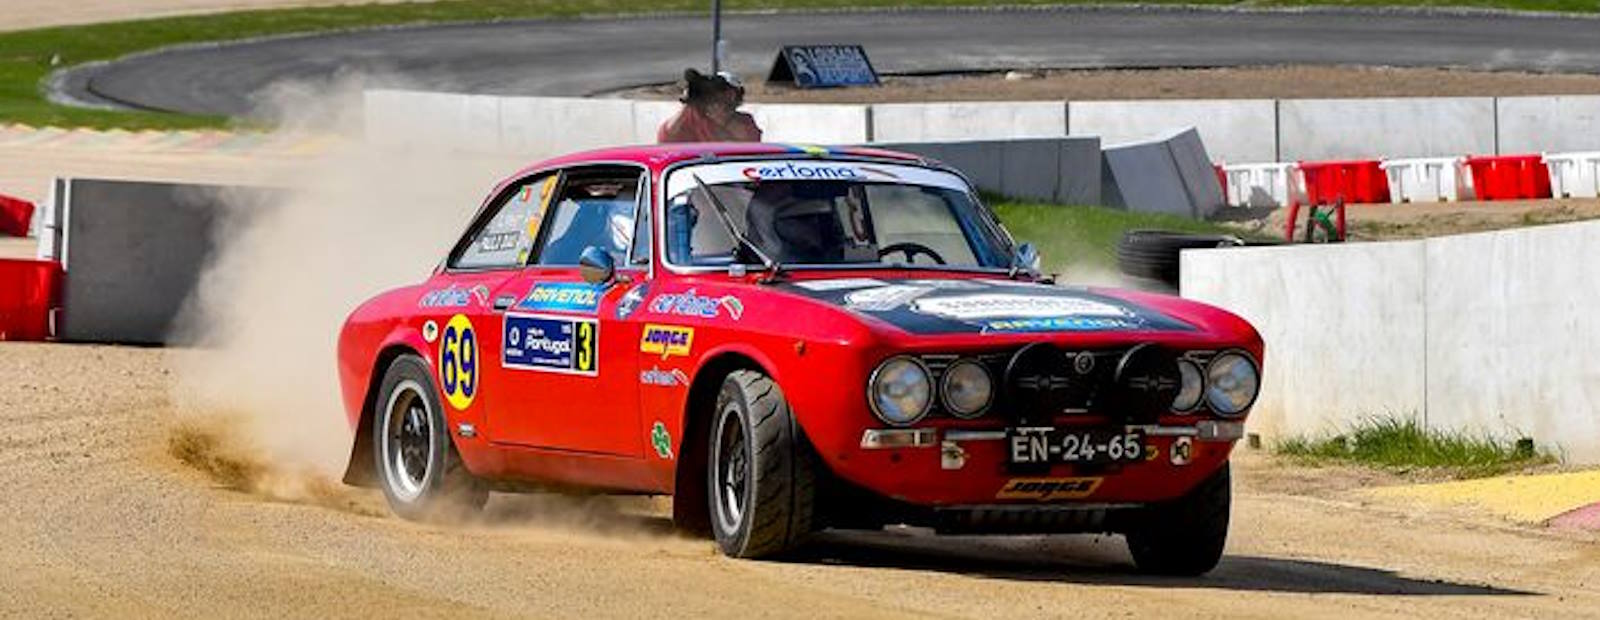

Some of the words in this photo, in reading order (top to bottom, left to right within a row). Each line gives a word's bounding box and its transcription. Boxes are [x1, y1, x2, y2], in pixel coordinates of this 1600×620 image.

[743, 163, 856, 181] certoma
[527, 286, 598, 305] RAVENOL
[525, 334, 571, 354] Portugal
[578, 322, 592, 370] 3
[645, 328, 689, 346] JORGE
[442, 326, 475, 397] 69
[1011, 434, 1140, 463] EN-24-65
